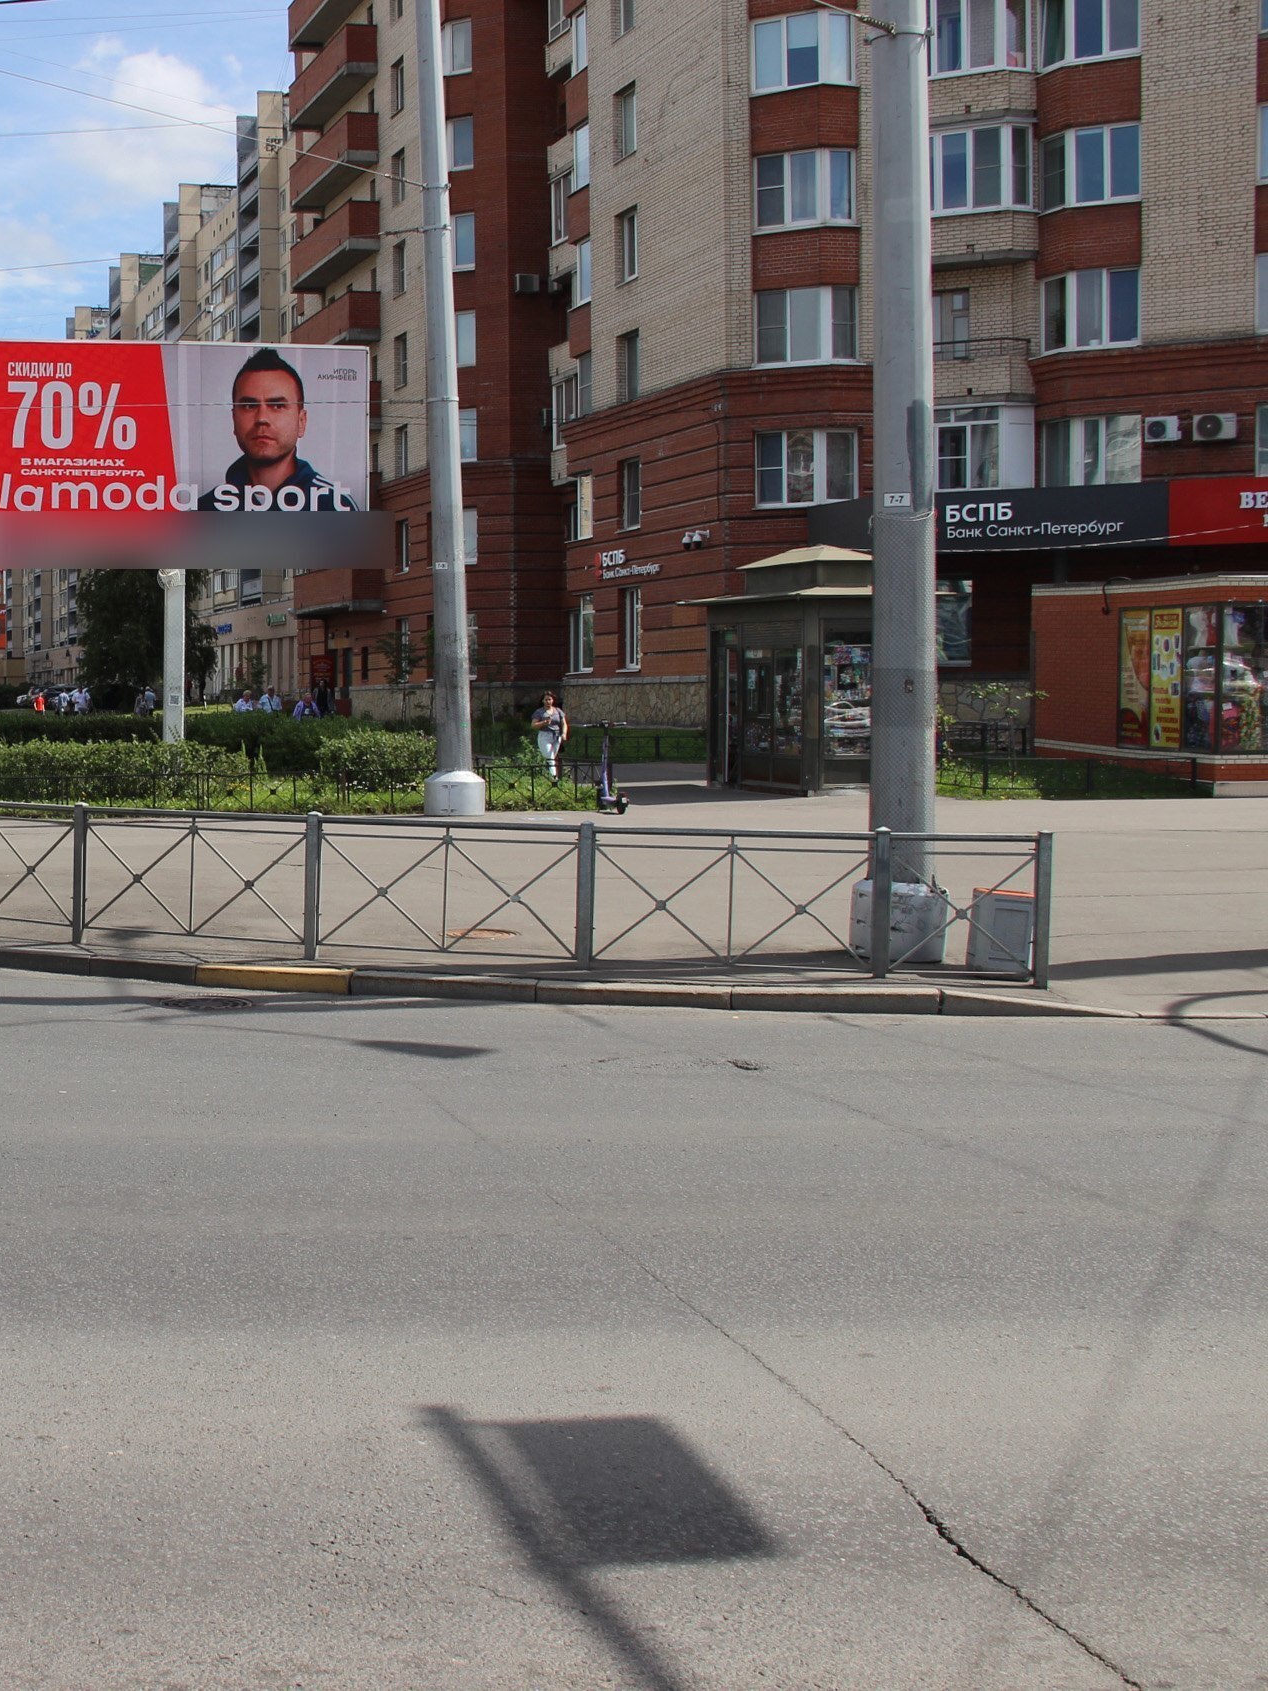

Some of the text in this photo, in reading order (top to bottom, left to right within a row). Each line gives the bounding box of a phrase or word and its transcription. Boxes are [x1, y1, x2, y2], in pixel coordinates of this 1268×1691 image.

[7, 361, 72, 379] СКИДКИ ДО
[333, 368, 357, 376] ИГОРЬ
[7, 380, 137, 450] 70%
[20, 457, 125, 467] В МАГАЗИНАХ
[20, 468, 146, 477] САНКТ-ПЕТЕРБУРГА
[0, 473, 352, 512] lamoda sport
[888, 495, 905, 504] 7-7
[945, 502, 1013, 523] БСПБ
[946, 519, 1125, 539] Банк Санкт-Петербург
[602, 549, 626, 567] БСПБ
[602, 562, 661, 580] Банк Санкт-Петербург
